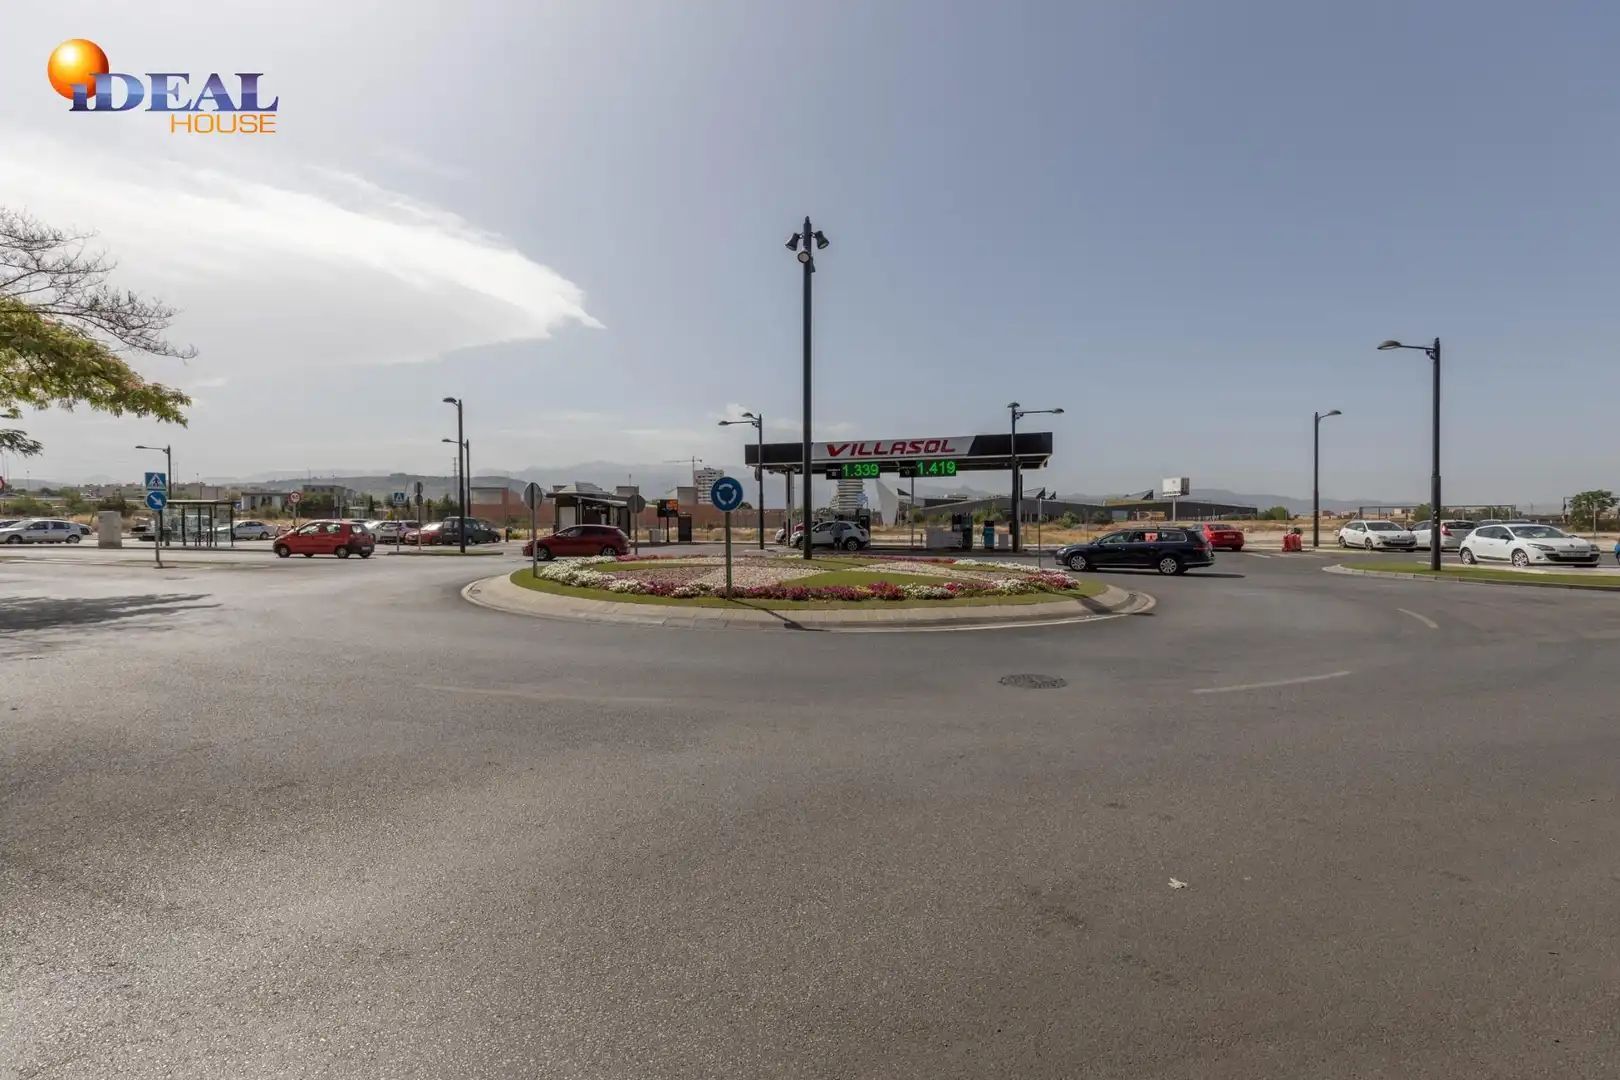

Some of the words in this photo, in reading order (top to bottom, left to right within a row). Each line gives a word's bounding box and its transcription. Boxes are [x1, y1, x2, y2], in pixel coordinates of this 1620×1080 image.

[826, 439, 956, 457] VILLASOL
[842, 463, 879, 477] 1.339
[917, 460, 956, 476] 1.419
